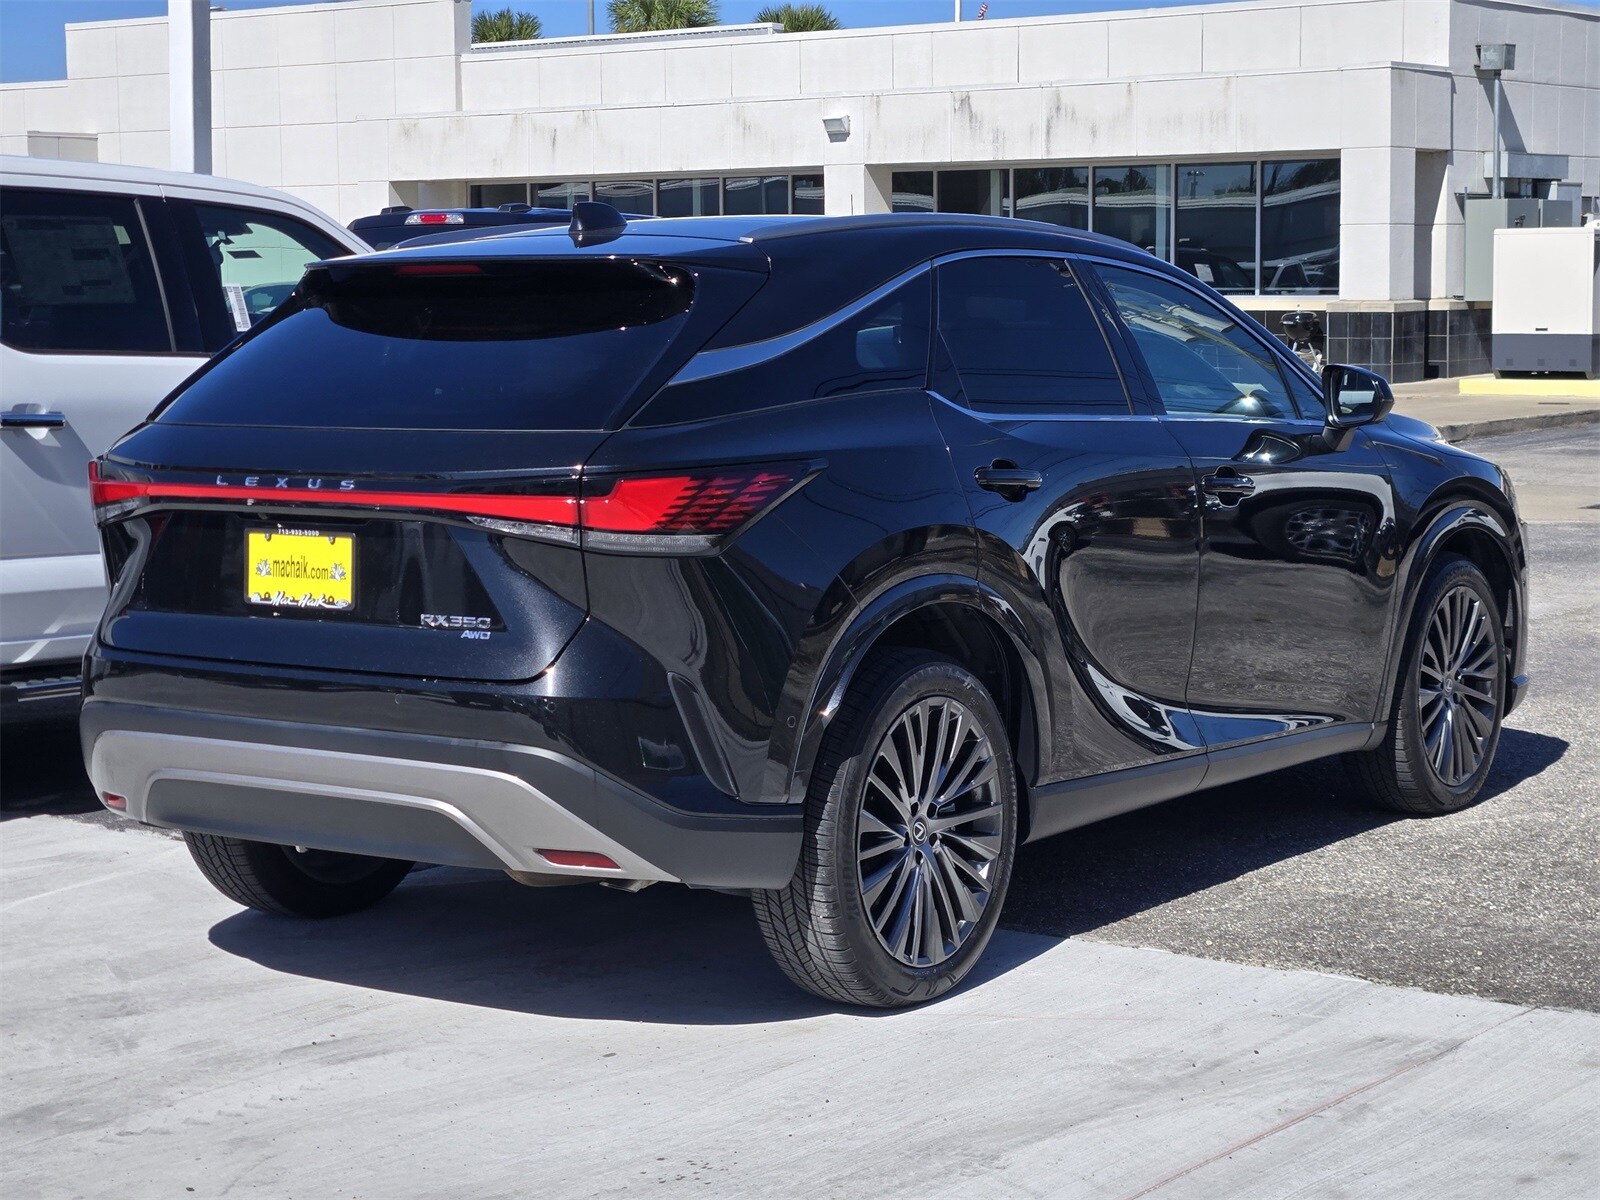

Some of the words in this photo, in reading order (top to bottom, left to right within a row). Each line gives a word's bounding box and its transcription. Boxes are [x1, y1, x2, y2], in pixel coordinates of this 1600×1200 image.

[216, 475, 355, 490] LEXUS
[272, 555, 329, 580] machaik.com
[271, 591, 298, 607] Mac
[420, 613, 491, 629] RX350
[460, 629, 491, 640] AWD
